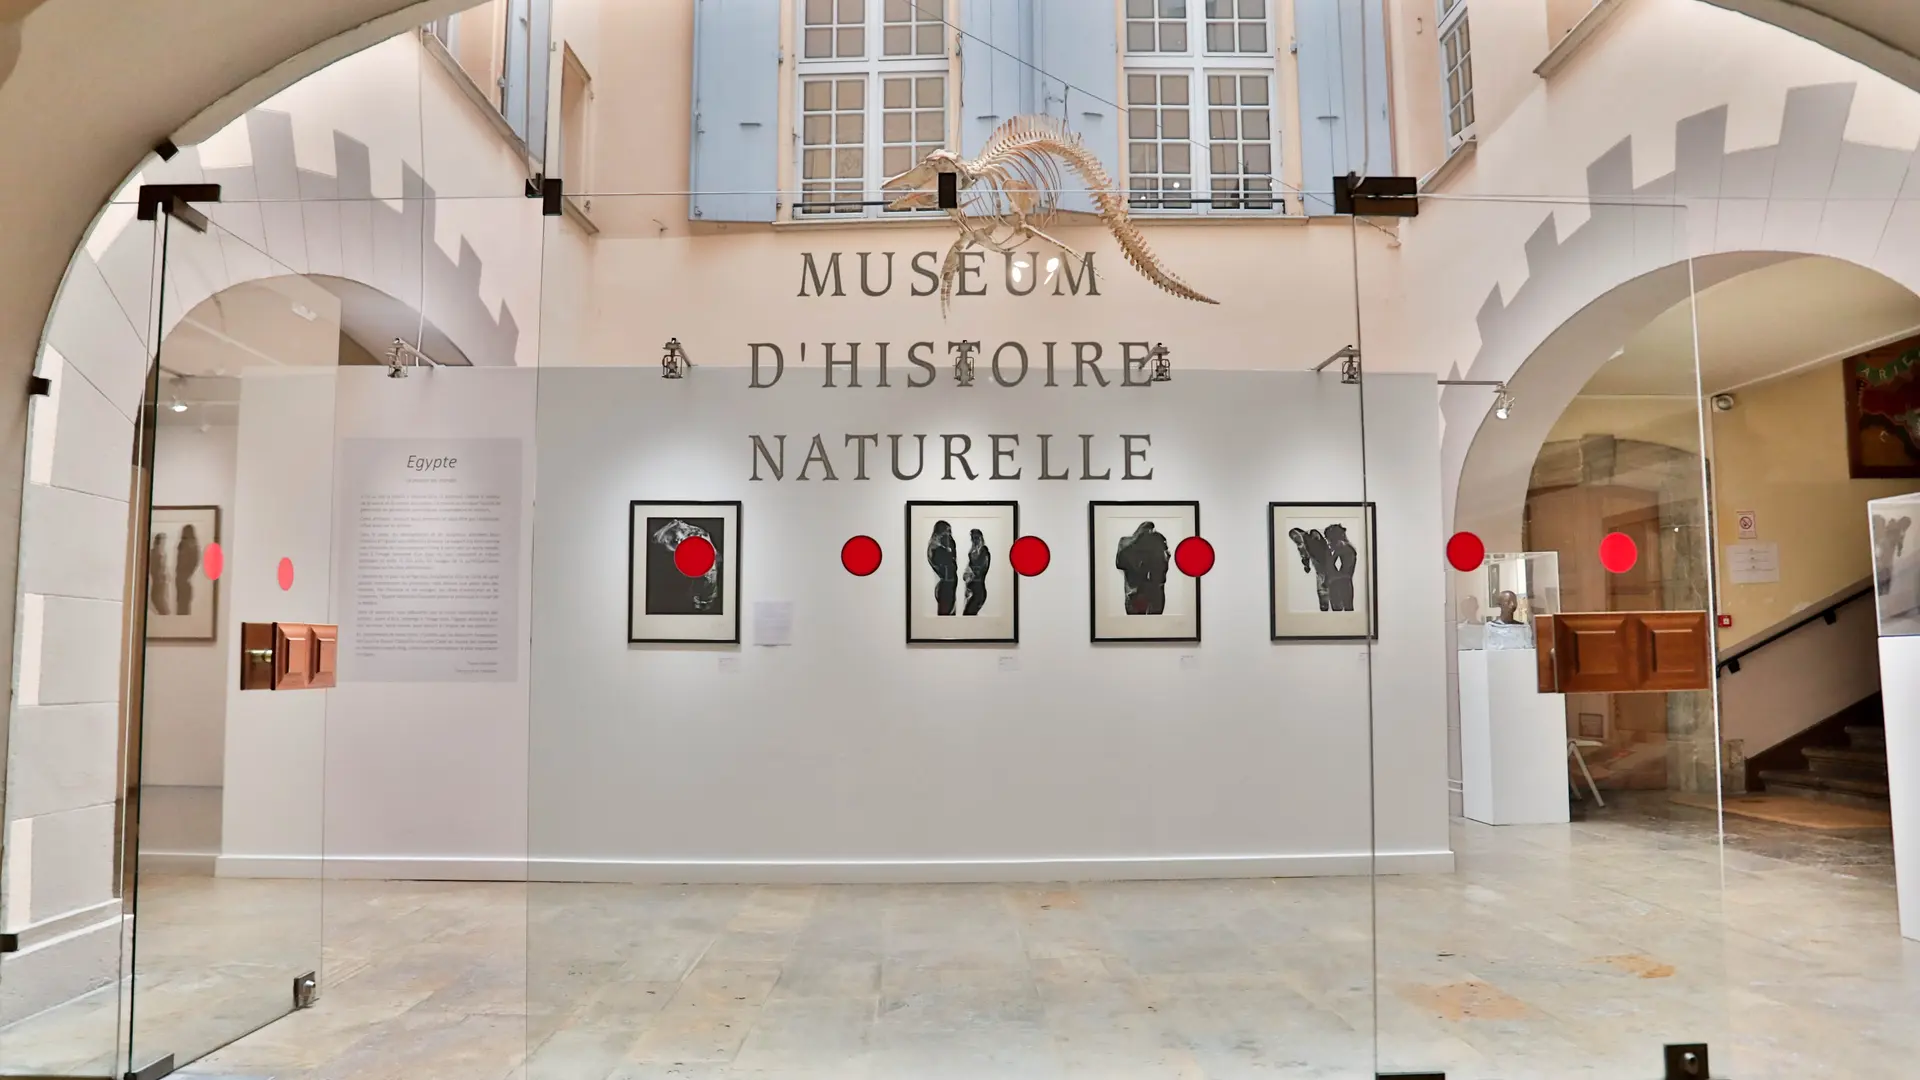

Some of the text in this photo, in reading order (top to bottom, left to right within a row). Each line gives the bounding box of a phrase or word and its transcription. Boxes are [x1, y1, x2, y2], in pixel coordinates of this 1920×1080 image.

[747, 341, 1153, 388] D'HISTOIRE
[407, 455, 457, 471] Egypte
[748, 433, 1154, 481] NATURELLE
